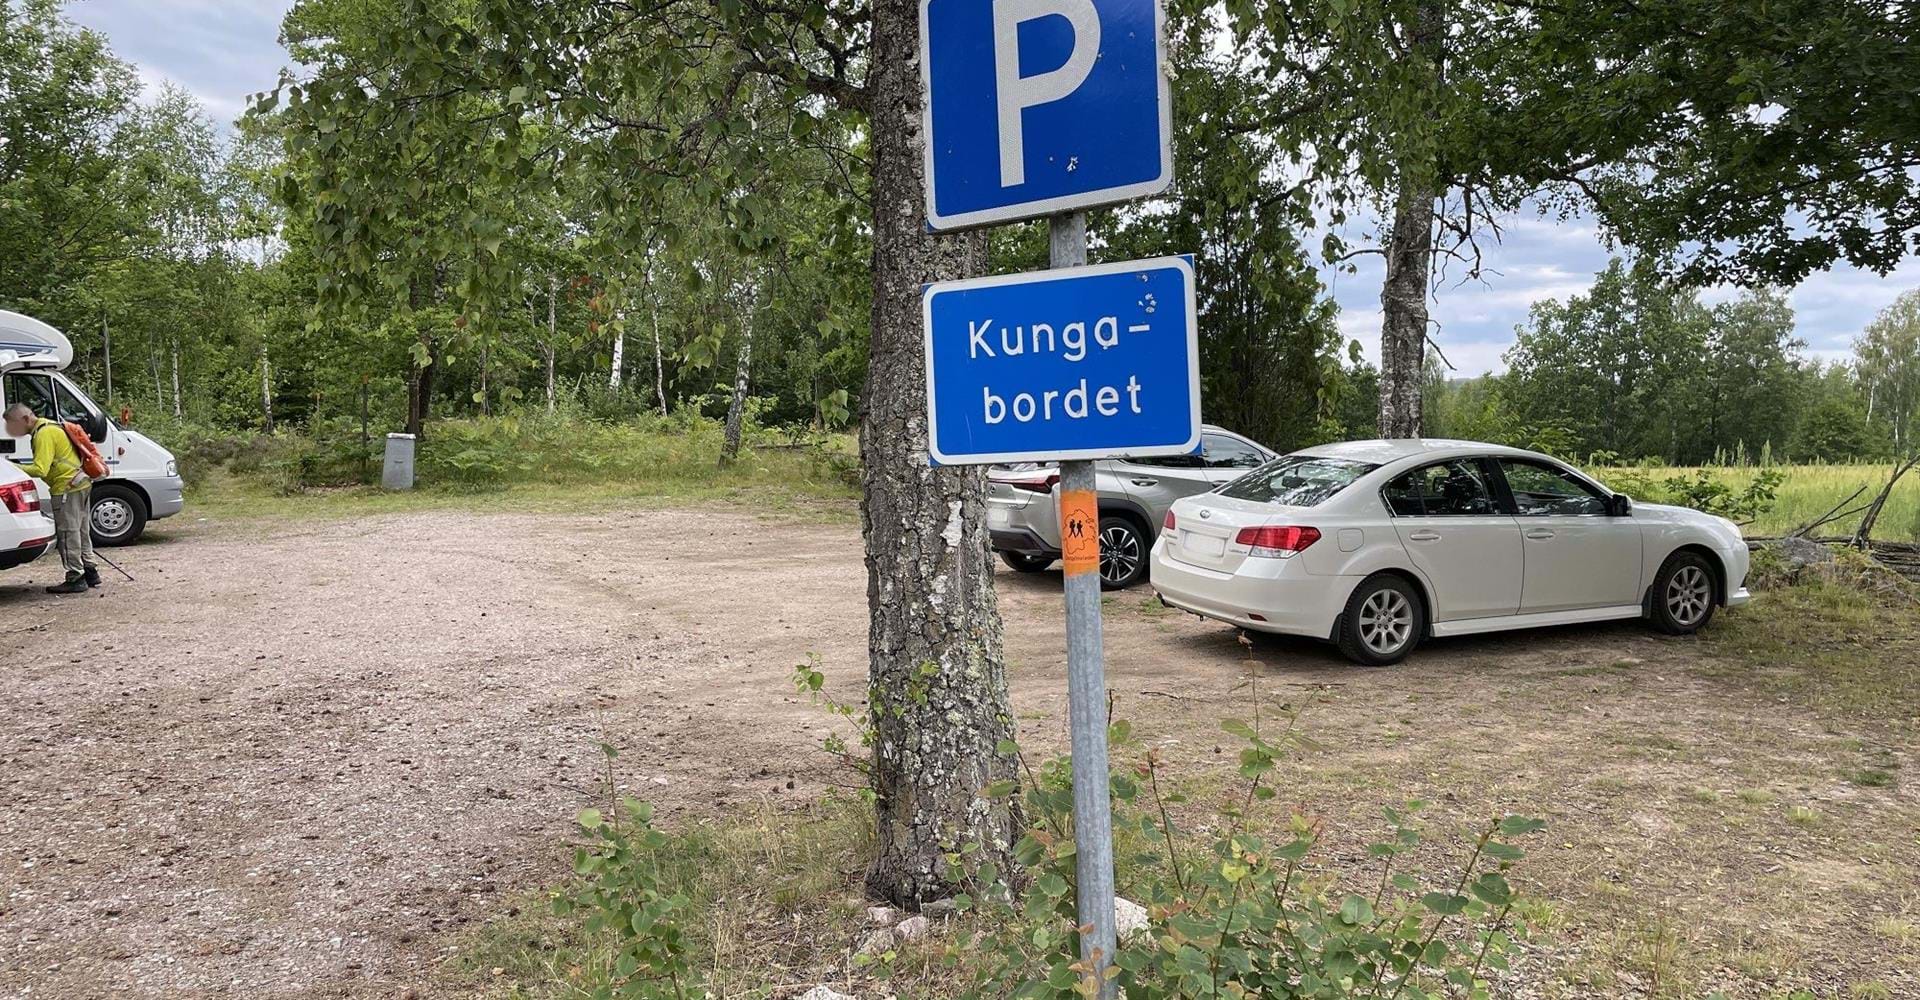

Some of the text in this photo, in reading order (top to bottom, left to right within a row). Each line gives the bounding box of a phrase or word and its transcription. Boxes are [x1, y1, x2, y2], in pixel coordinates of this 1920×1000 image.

[992, 0, 1101, 188] P
[969, 316, 1151, 362] Kunga-
[983, 375, 1142, 425] bordet
